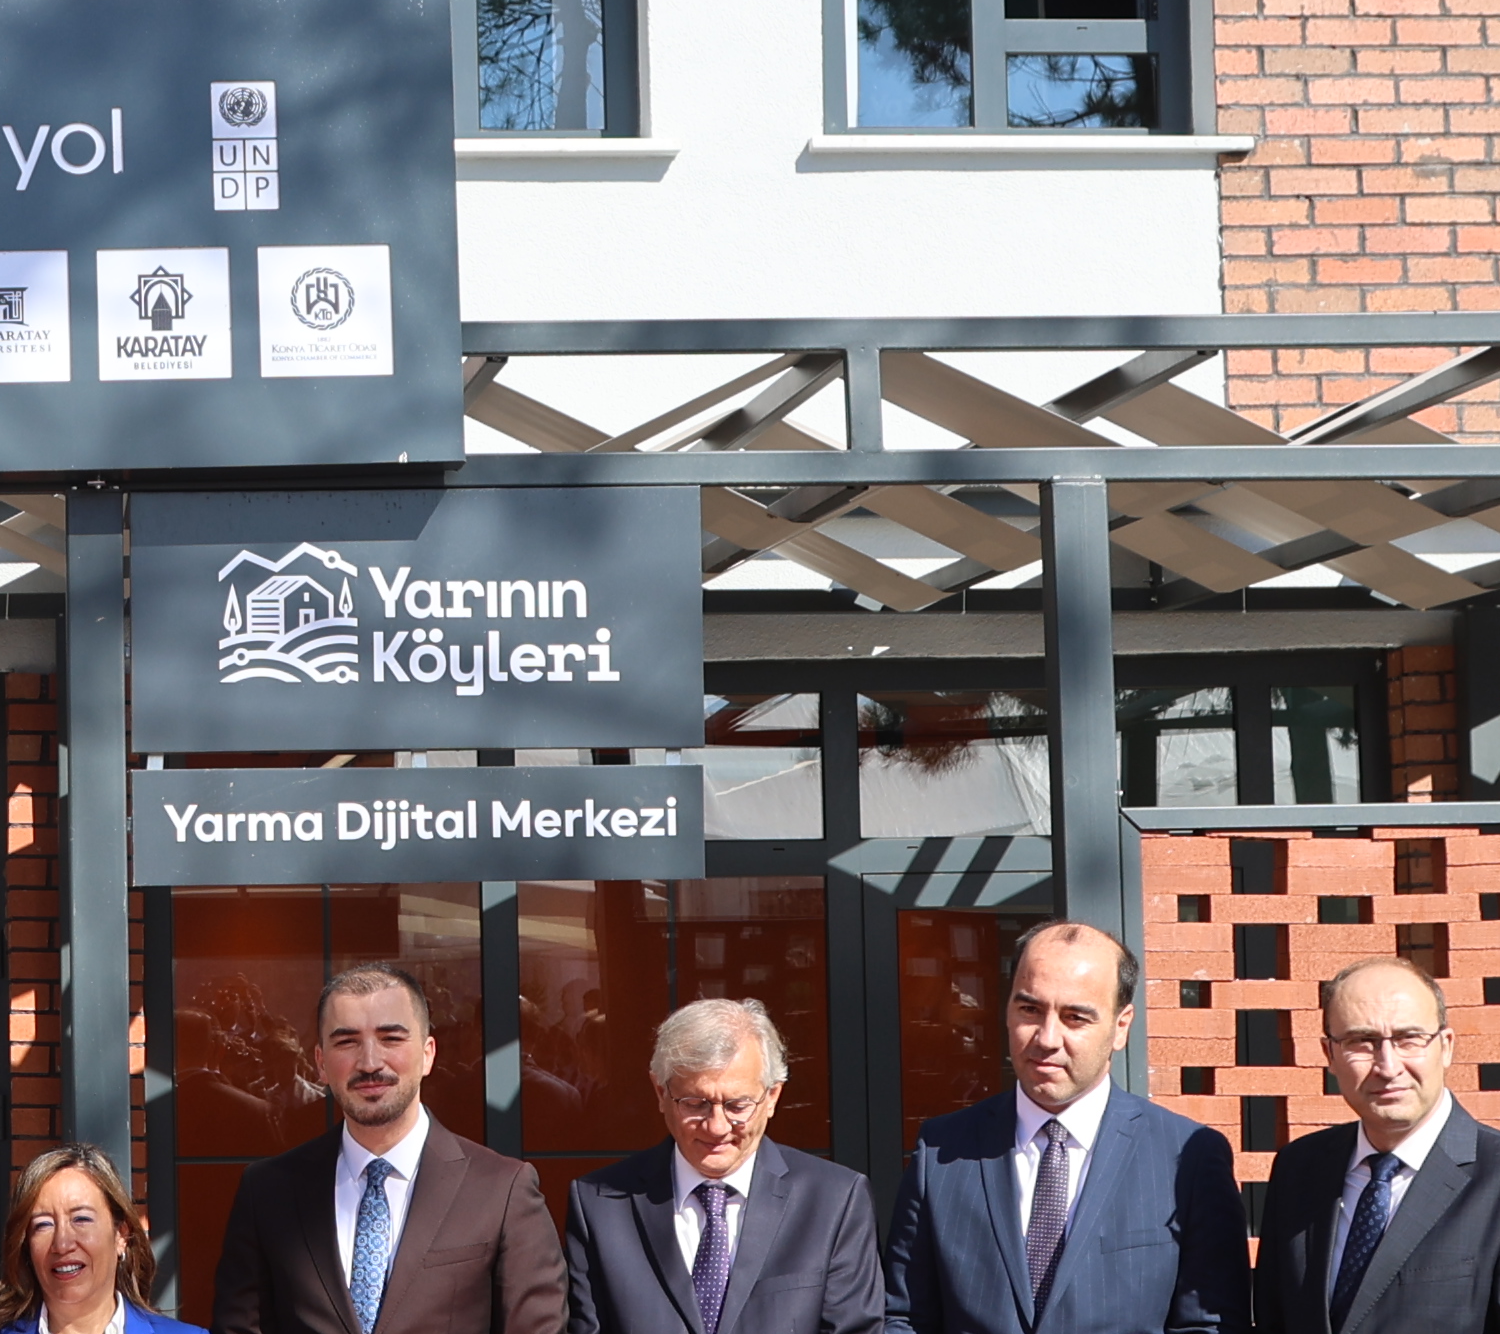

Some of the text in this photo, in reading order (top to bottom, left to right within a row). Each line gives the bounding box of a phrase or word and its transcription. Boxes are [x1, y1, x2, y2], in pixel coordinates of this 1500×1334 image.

[116, 335, 207, 358] KARATAY
[368, 567, 588, 618] Yarının
[373, 628, 621, 696] Köyleri
[164, 796, 678, 851] Yarma Dijital Merkezi
